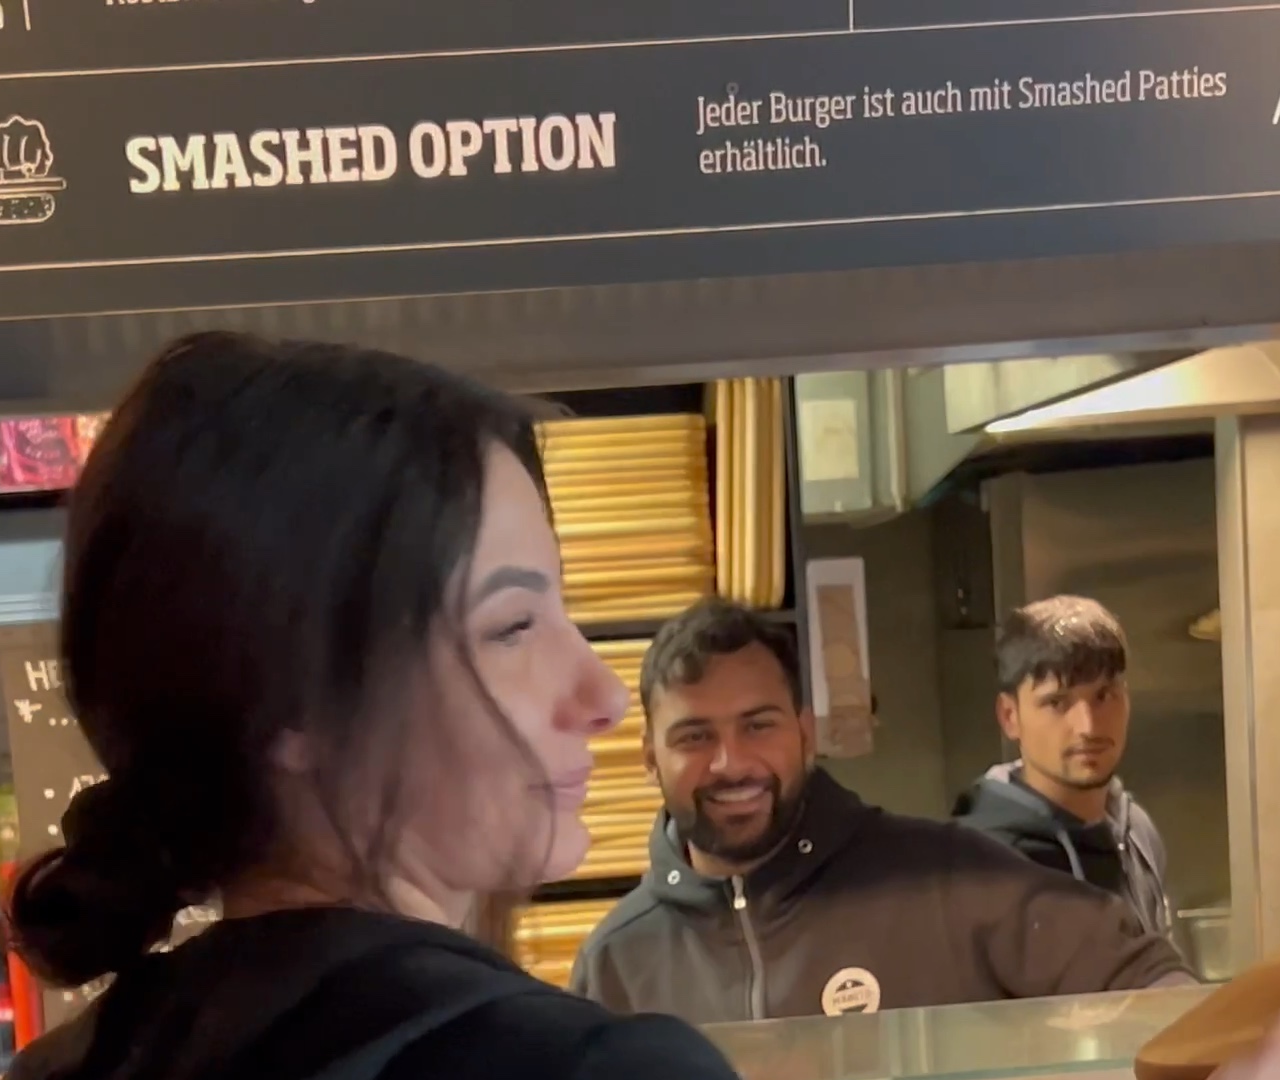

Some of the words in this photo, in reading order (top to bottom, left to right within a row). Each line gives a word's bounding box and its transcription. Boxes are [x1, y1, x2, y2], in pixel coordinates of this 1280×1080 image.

[697, 95, 762, 135] Jeder
[769, 90, 856, 130] Burger
[861, 90, 894, 118] ist
[901, 84, 962, 116] auch
[969, 81, 1012, 112] mit
[1017, 73, 1132, 108] Smashed
[1138, 65, 1228, 100] Patties
[125, 122, 398, 194] SMASHED
[408, 112, 617, 178] OPTION
[698, 138, 827, 174] erhältlich.
